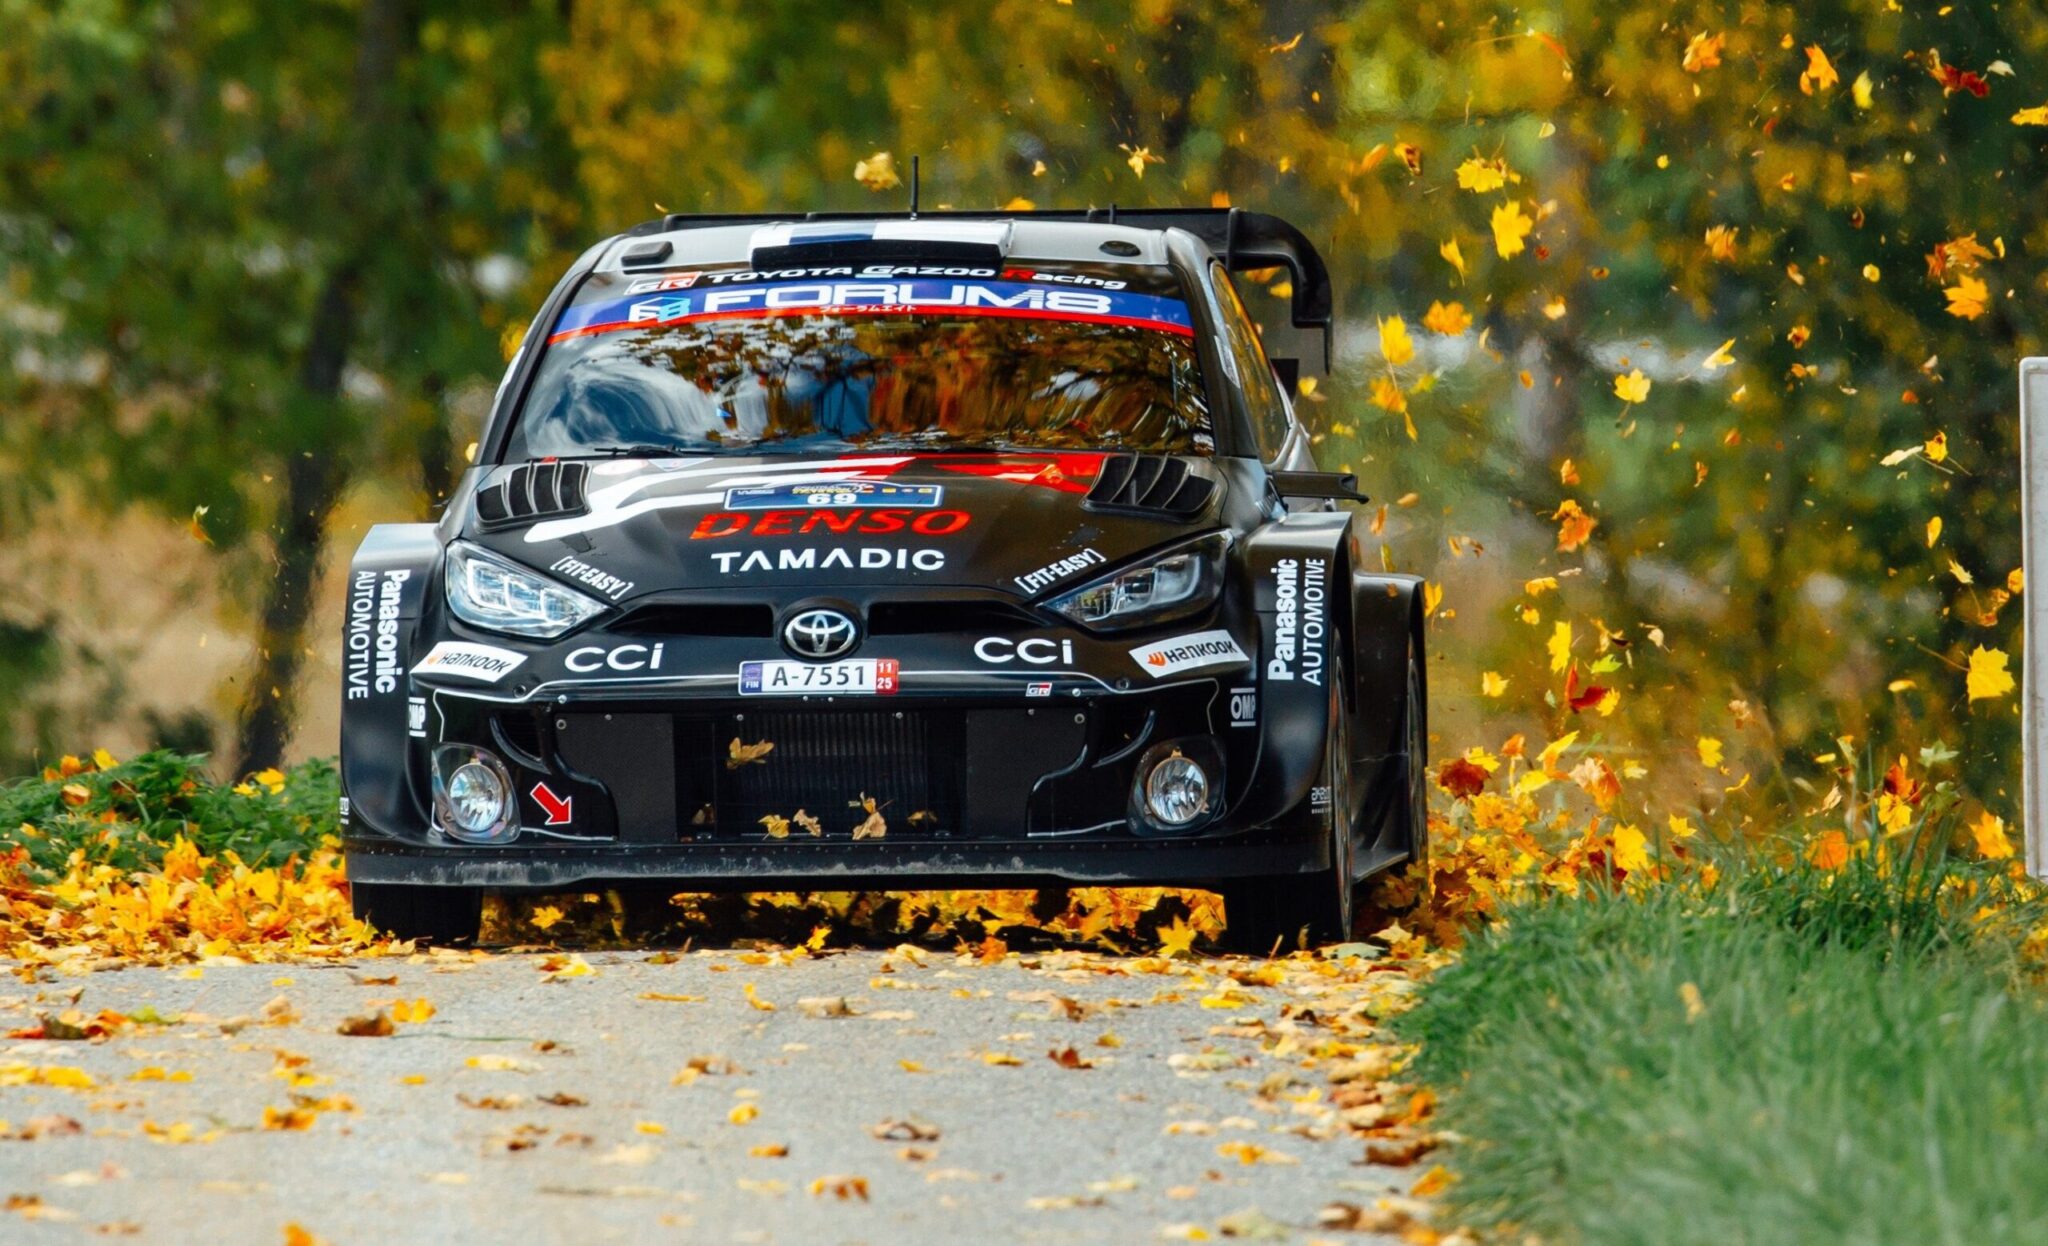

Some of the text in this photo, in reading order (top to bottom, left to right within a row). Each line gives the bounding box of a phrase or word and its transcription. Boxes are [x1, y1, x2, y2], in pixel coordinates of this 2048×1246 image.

[707, 266, 852, 284] TOYOTA
[857, 265, 997, 279] GAZOO
[1002, 267, 1128, 290] Racing
[704, 284, 1112, 314] FORUM8
[807, 493, 857, 505] 69
[689, 509, 972, 539] DENSO
[711, 548, 945, 573] TAMADIC
[375, 568, 412, 694] Panasonic
[1267, 558, 1299, 681] Panasonic
[1302, 558, 1325, 686] AUTOMOTIVE
[348, 571, 377, 700] AUTOMOTIVE
[745, 666, 864, 689] FIN A-7551
[878, 662, 893, 673] 11
[876, 677, 893, 689] 25
